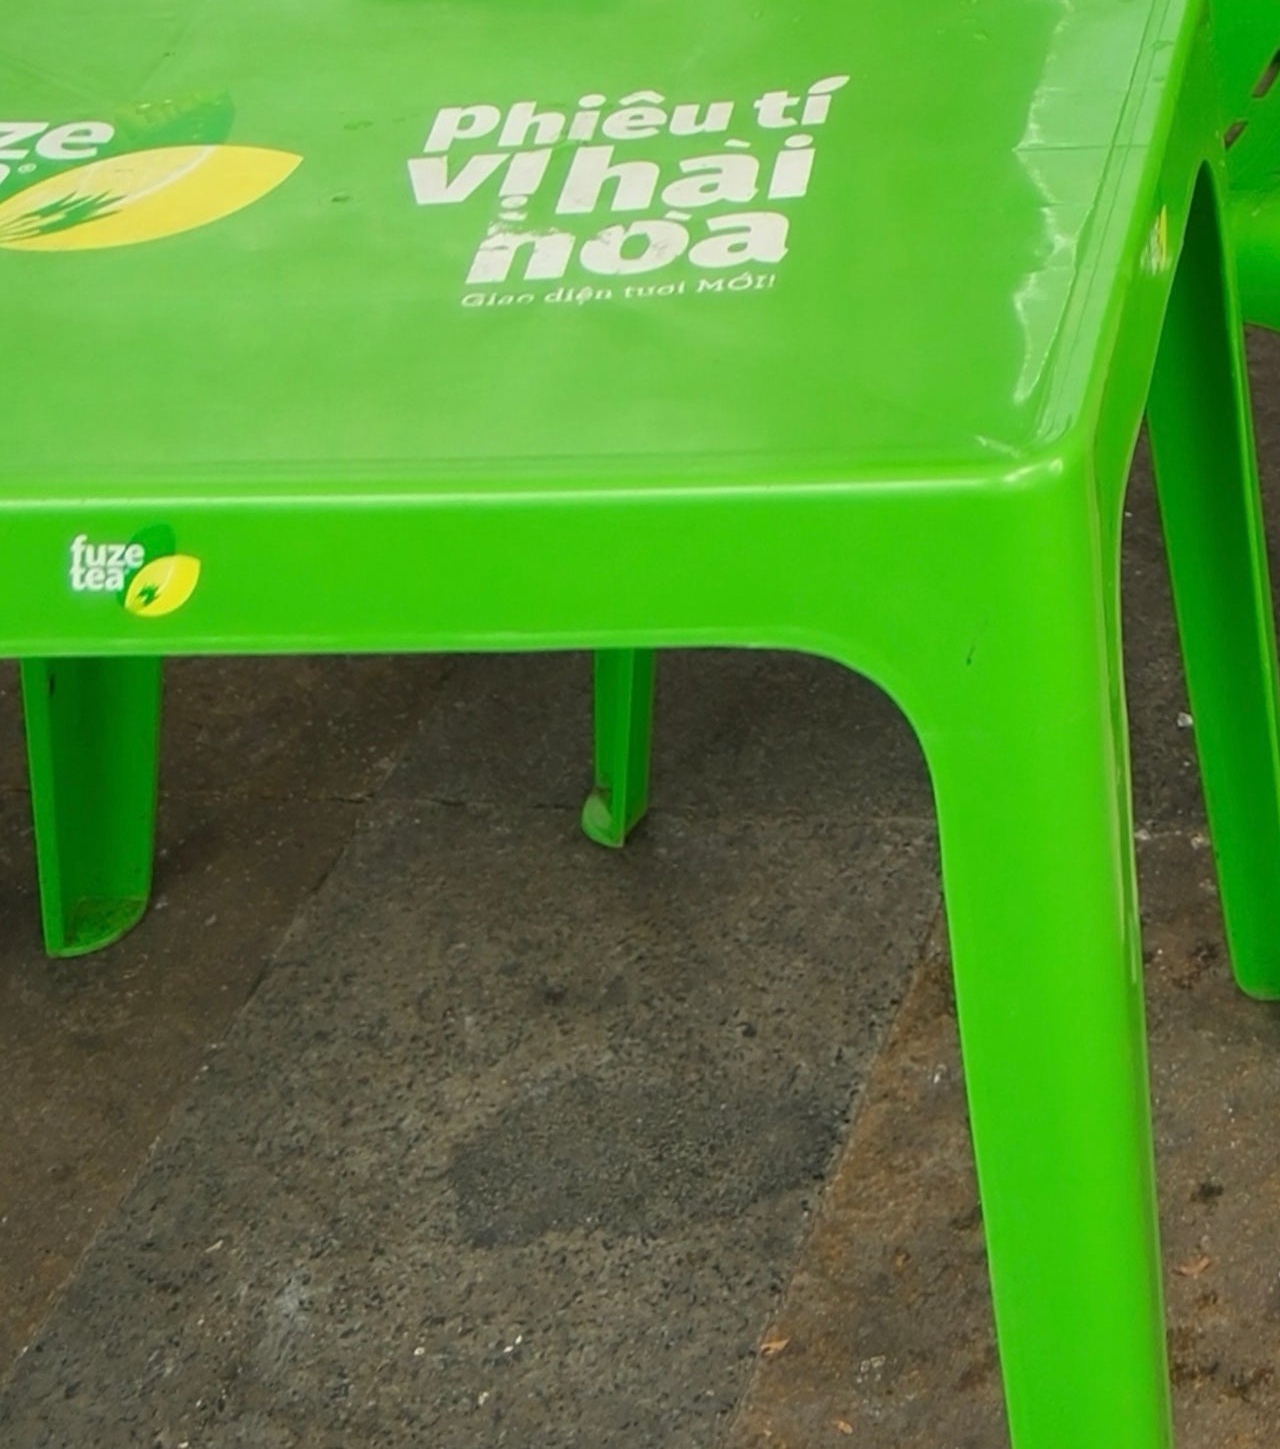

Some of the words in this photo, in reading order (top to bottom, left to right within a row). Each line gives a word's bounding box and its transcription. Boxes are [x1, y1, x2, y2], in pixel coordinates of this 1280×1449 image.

[423, 90, 735, 153] Phiêu
[753, 75, 851, 129] tí
[407, 148, 553, 210] vị
[555, 134, 816, 215] hài
[70, 534, 146, 568] fuze
[70, 563, 126, 591] tea
